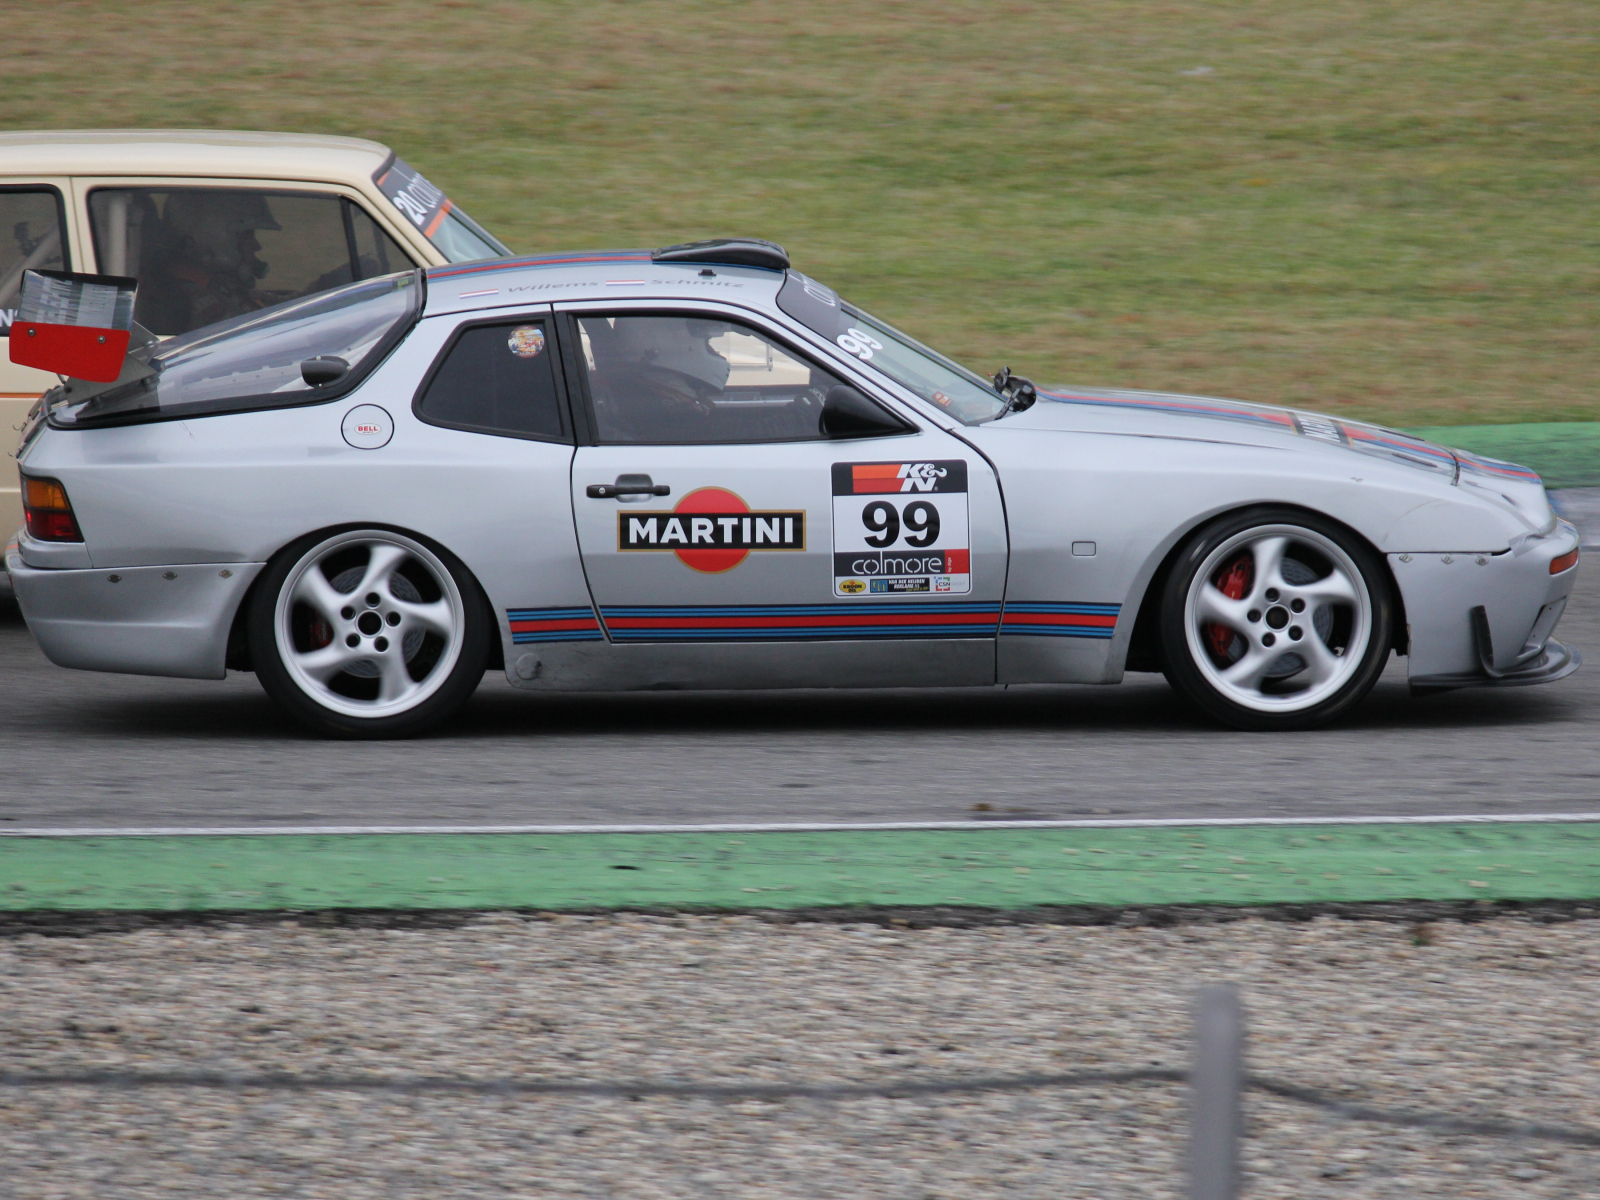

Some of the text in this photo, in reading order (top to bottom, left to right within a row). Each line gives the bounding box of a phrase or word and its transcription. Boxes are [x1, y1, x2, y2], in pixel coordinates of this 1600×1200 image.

[393, 189, 428, 226] 20
[508, 279, 745, 293] Willems Schmitz
[836, 327, 883, 360] 99
[896, 463, 948, 492] K&N
[628, 517, 794, 544] MARTINI
[861, 500, 941, 549] 99
[851, 550, 943, 576] colmore
